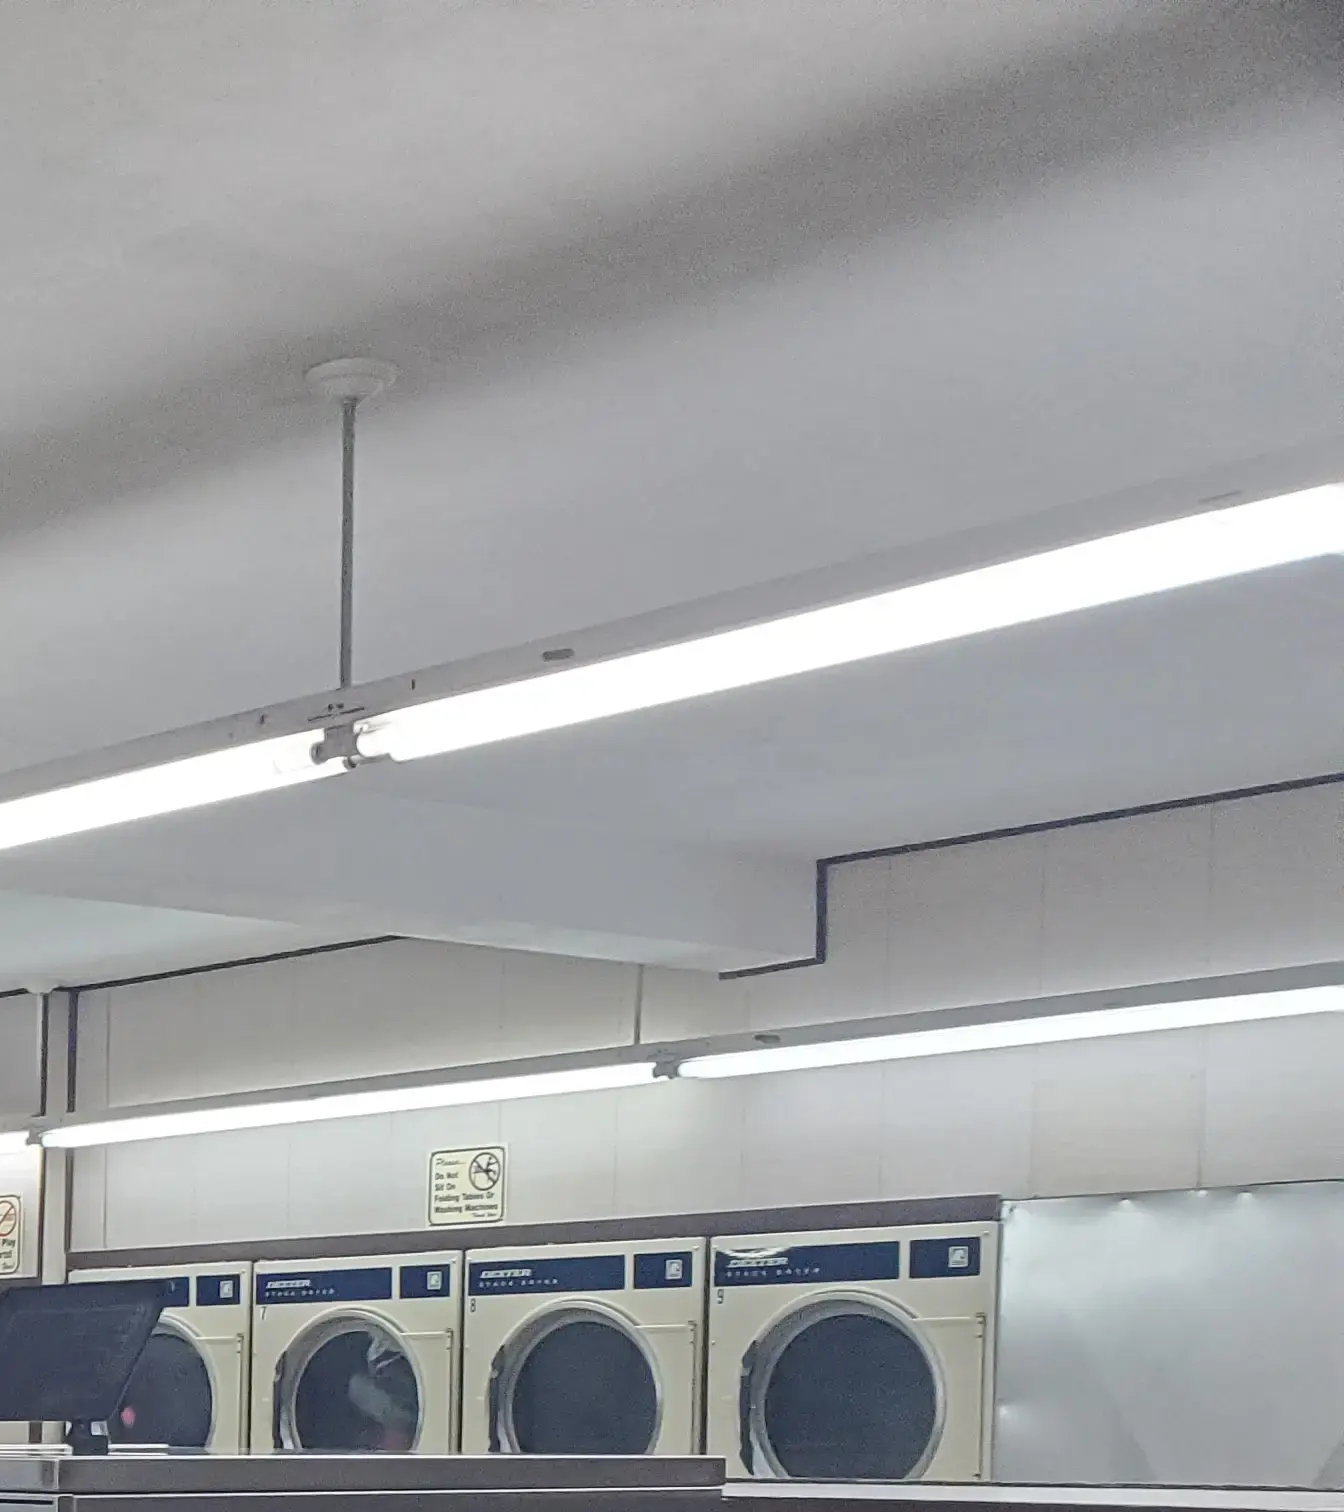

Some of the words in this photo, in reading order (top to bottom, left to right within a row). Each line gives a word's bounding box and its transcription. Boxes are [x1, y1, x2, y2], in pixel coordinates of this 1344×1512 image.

[2, 1239, 16, 1247] Play
[470, 1298, 477, 1313] 8
[260, 1306, 267, 1321] 7
